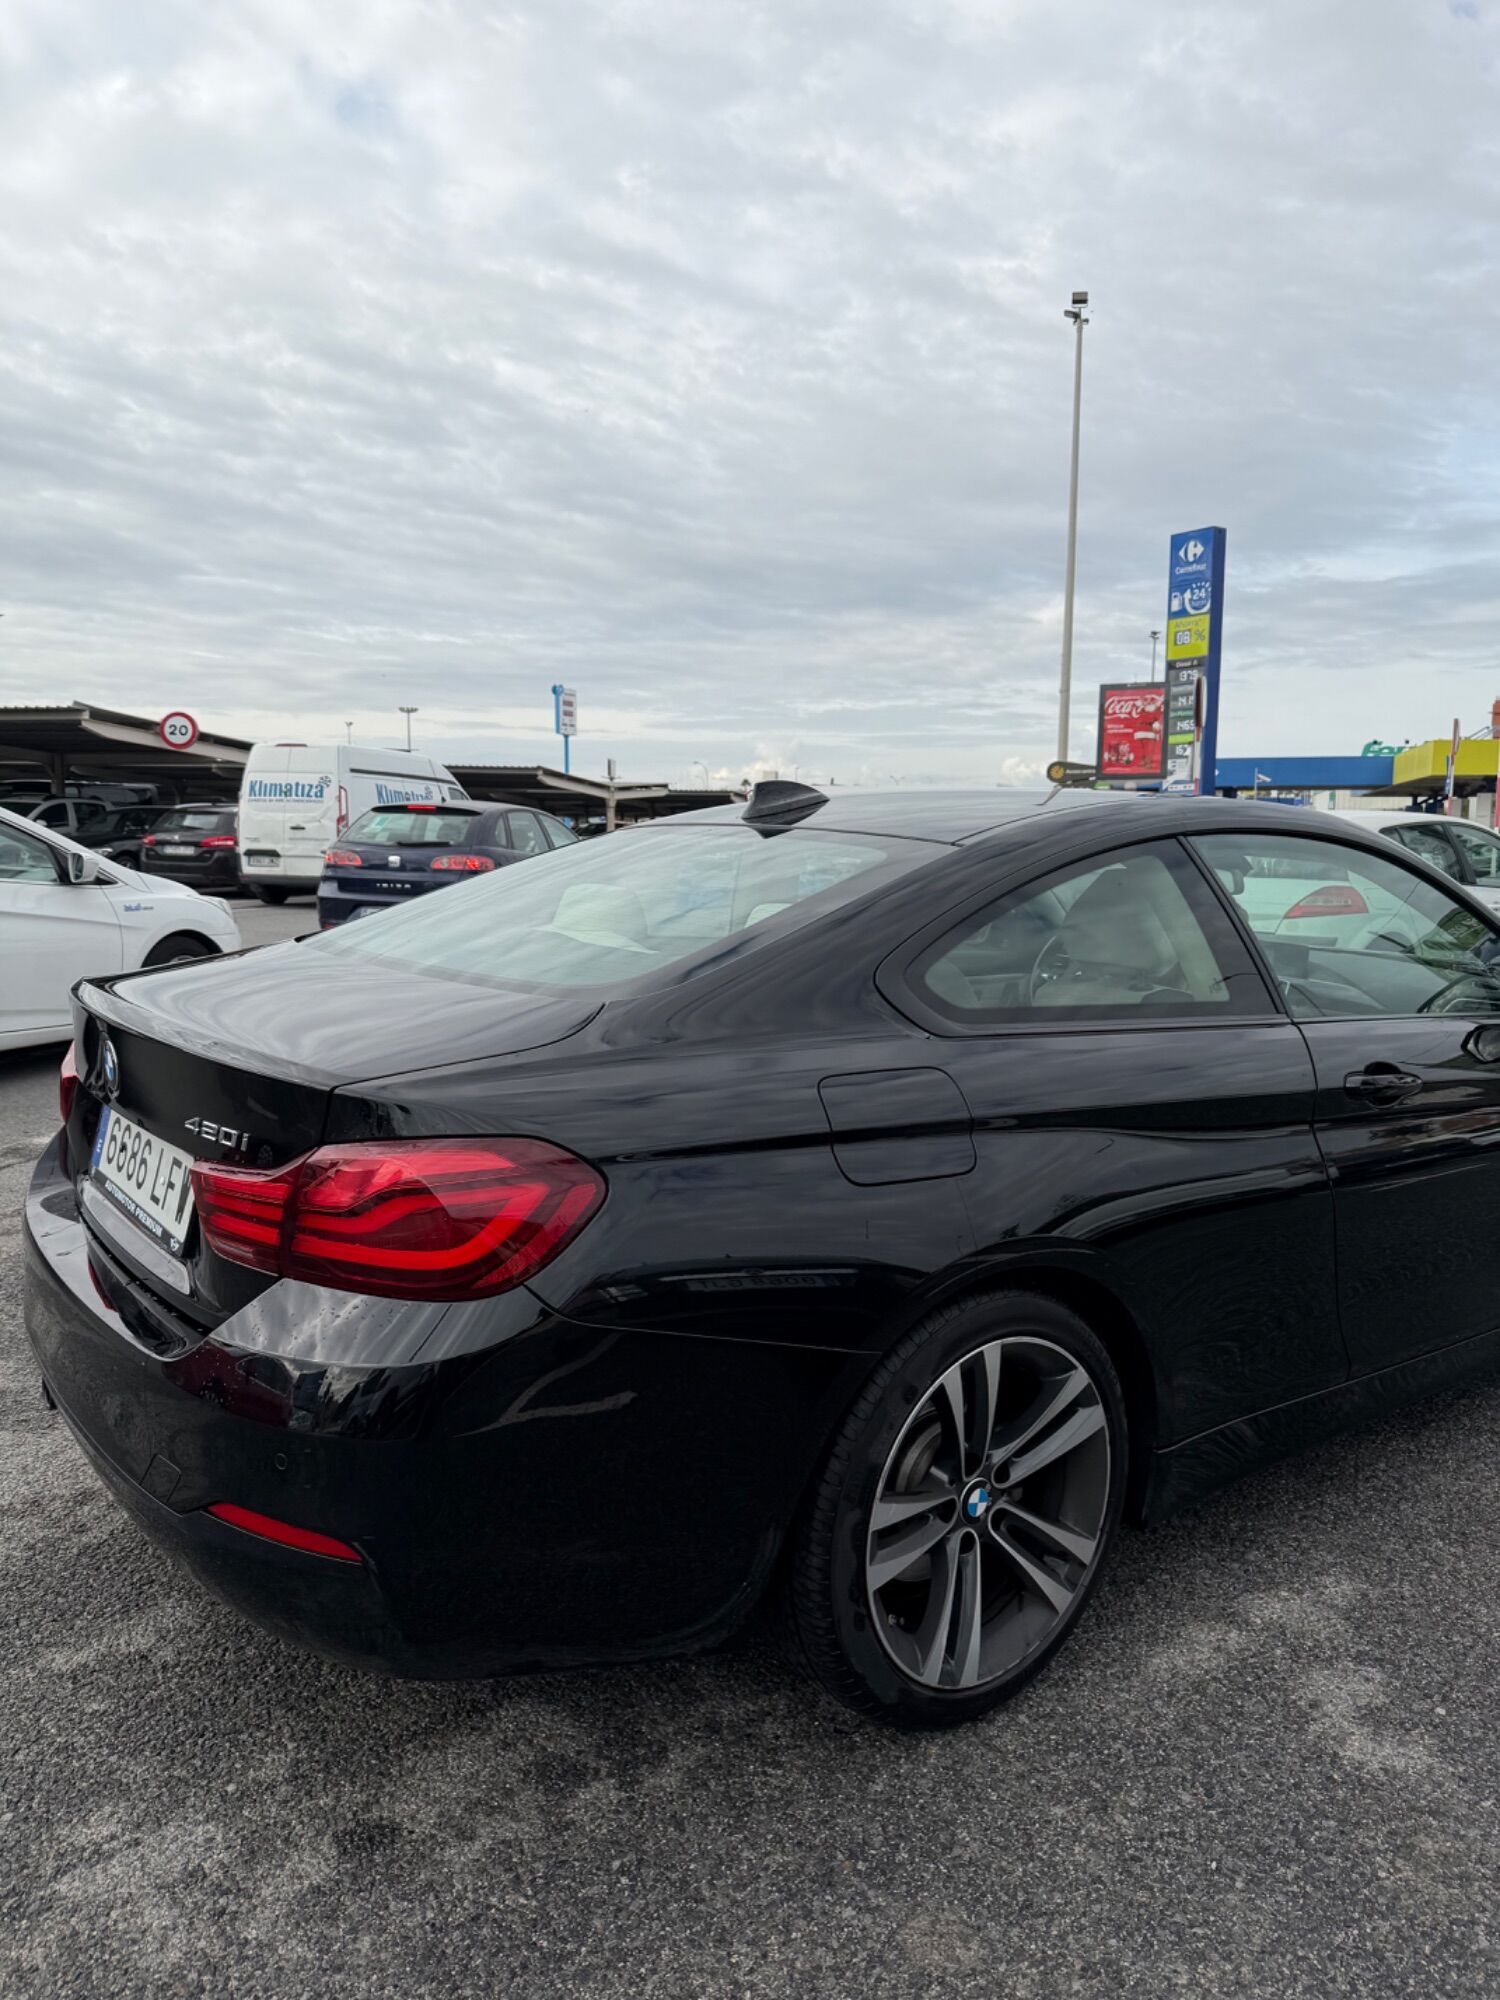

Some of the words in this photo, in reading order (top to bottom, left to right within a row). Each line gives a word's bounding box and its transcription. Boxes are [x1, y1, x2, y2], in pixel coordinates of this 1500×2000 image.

[1192, 588, 1206, 601] 24
[1194, 629, 1206, 642] %
[168, 724, 189, 736] 20
[249, 780, 325, 799] Klimatiza
[184, 1117, 249, 1152] 420i
[107, 1116, 152, 1190] 6686
[134, 1206, 164, 1238] PREMIUM
